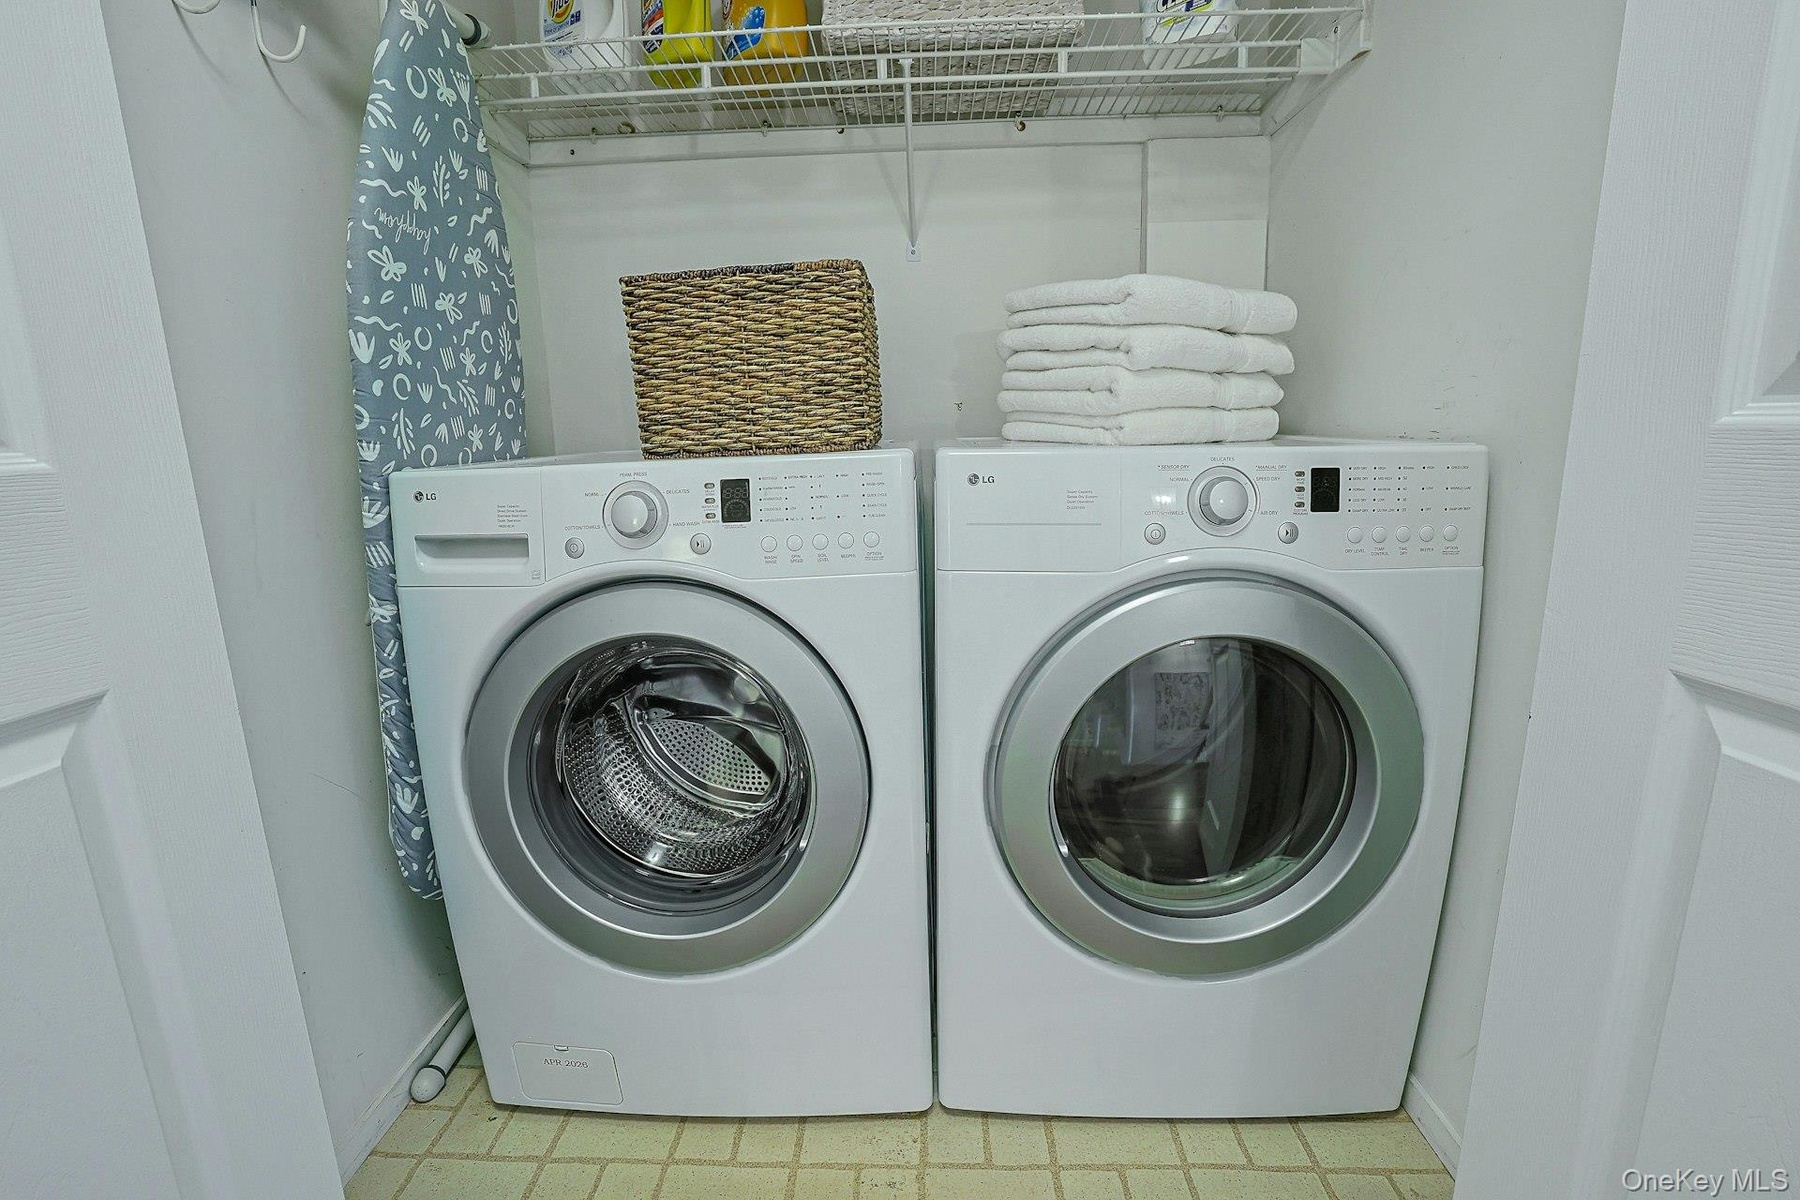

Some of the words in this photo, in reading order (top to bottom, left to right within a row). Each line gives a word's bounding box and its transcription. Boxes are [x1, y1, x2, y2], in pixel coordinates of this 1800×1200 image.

[982, 475, 995, 484] LG
[425, 492, 437, 501] LG
[543, 1058, 562, 1066] APR
